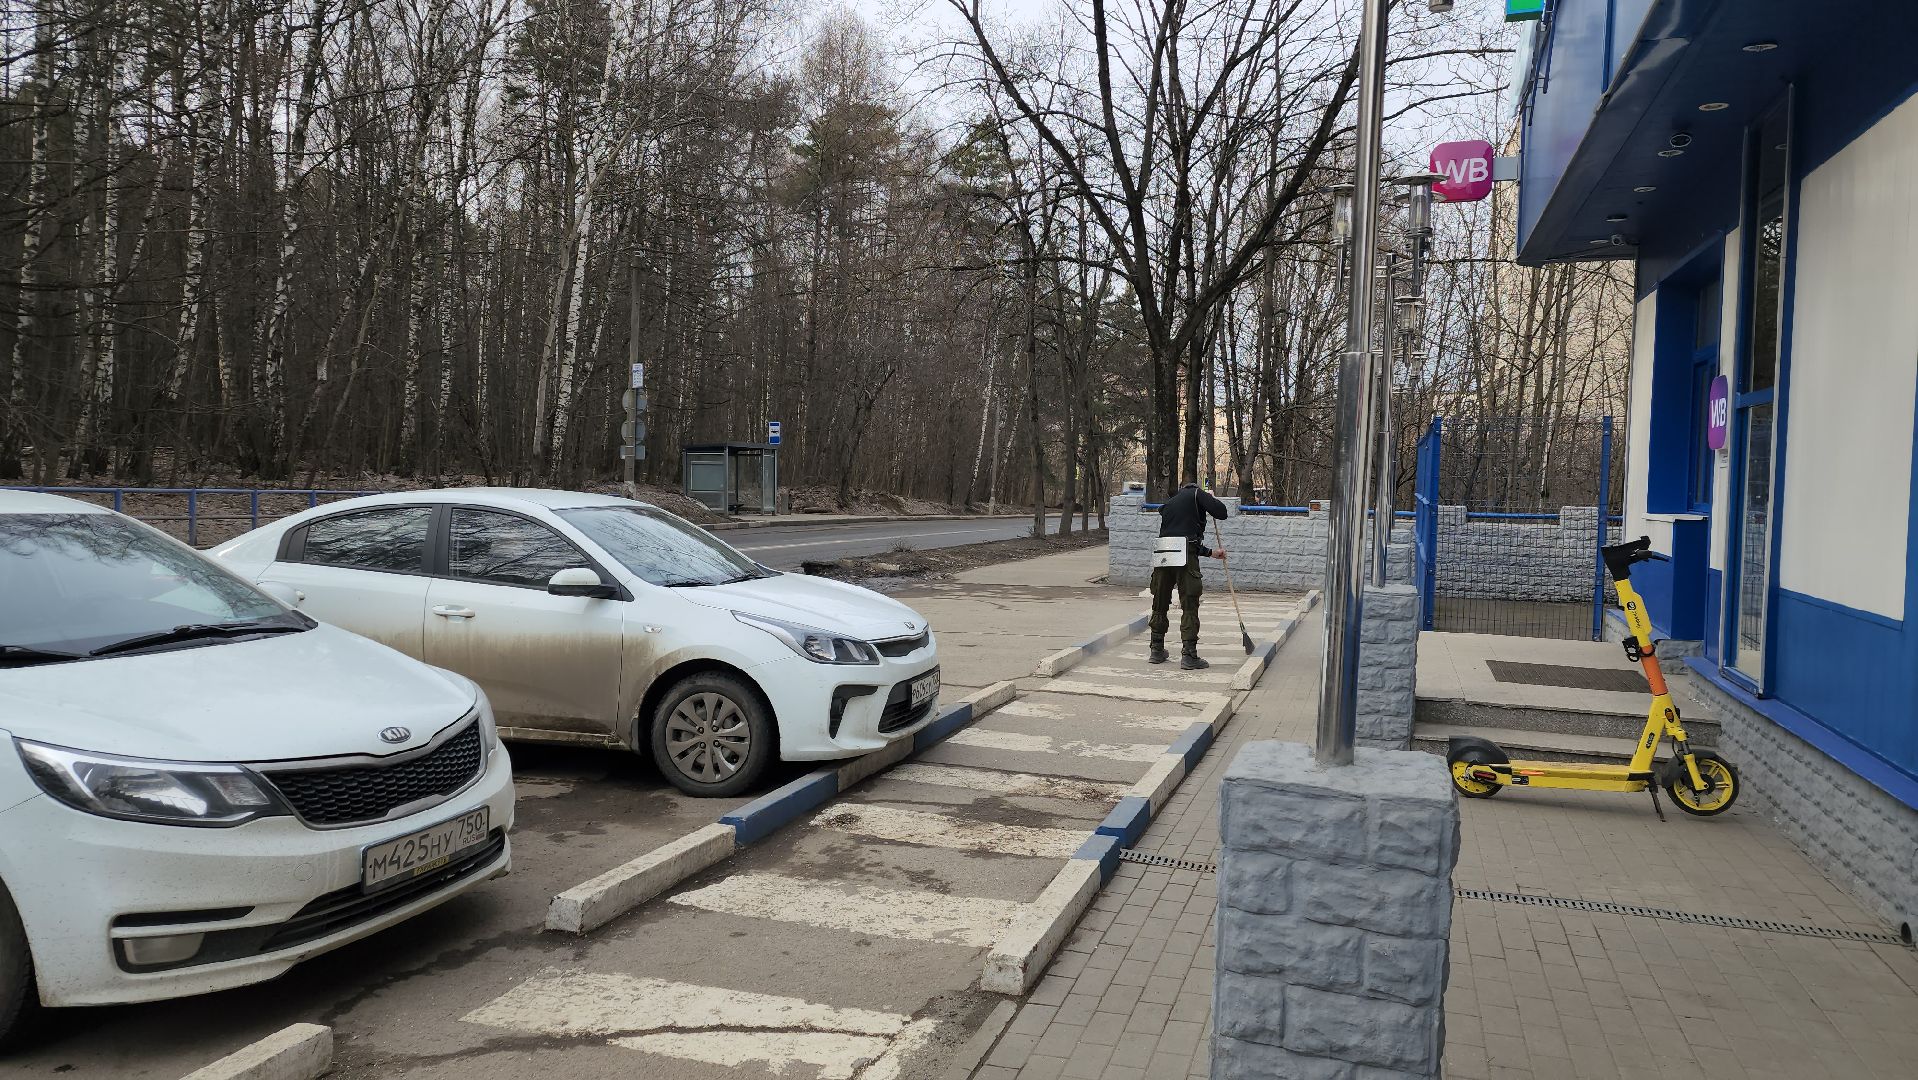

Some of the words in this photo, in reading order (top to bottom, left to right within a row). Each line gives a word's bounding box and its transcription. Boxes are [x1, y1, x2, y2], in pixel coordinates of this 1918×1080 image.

[1435, 157, 1489, 185] WB
[1711, 397, 1727, 428] WB
[381, 727, 410, 741] KIA
[372, 831, 454, 879] М425НУ
[458, 812, 484, 839] 750
[462, 835, 476, 846] RUS
